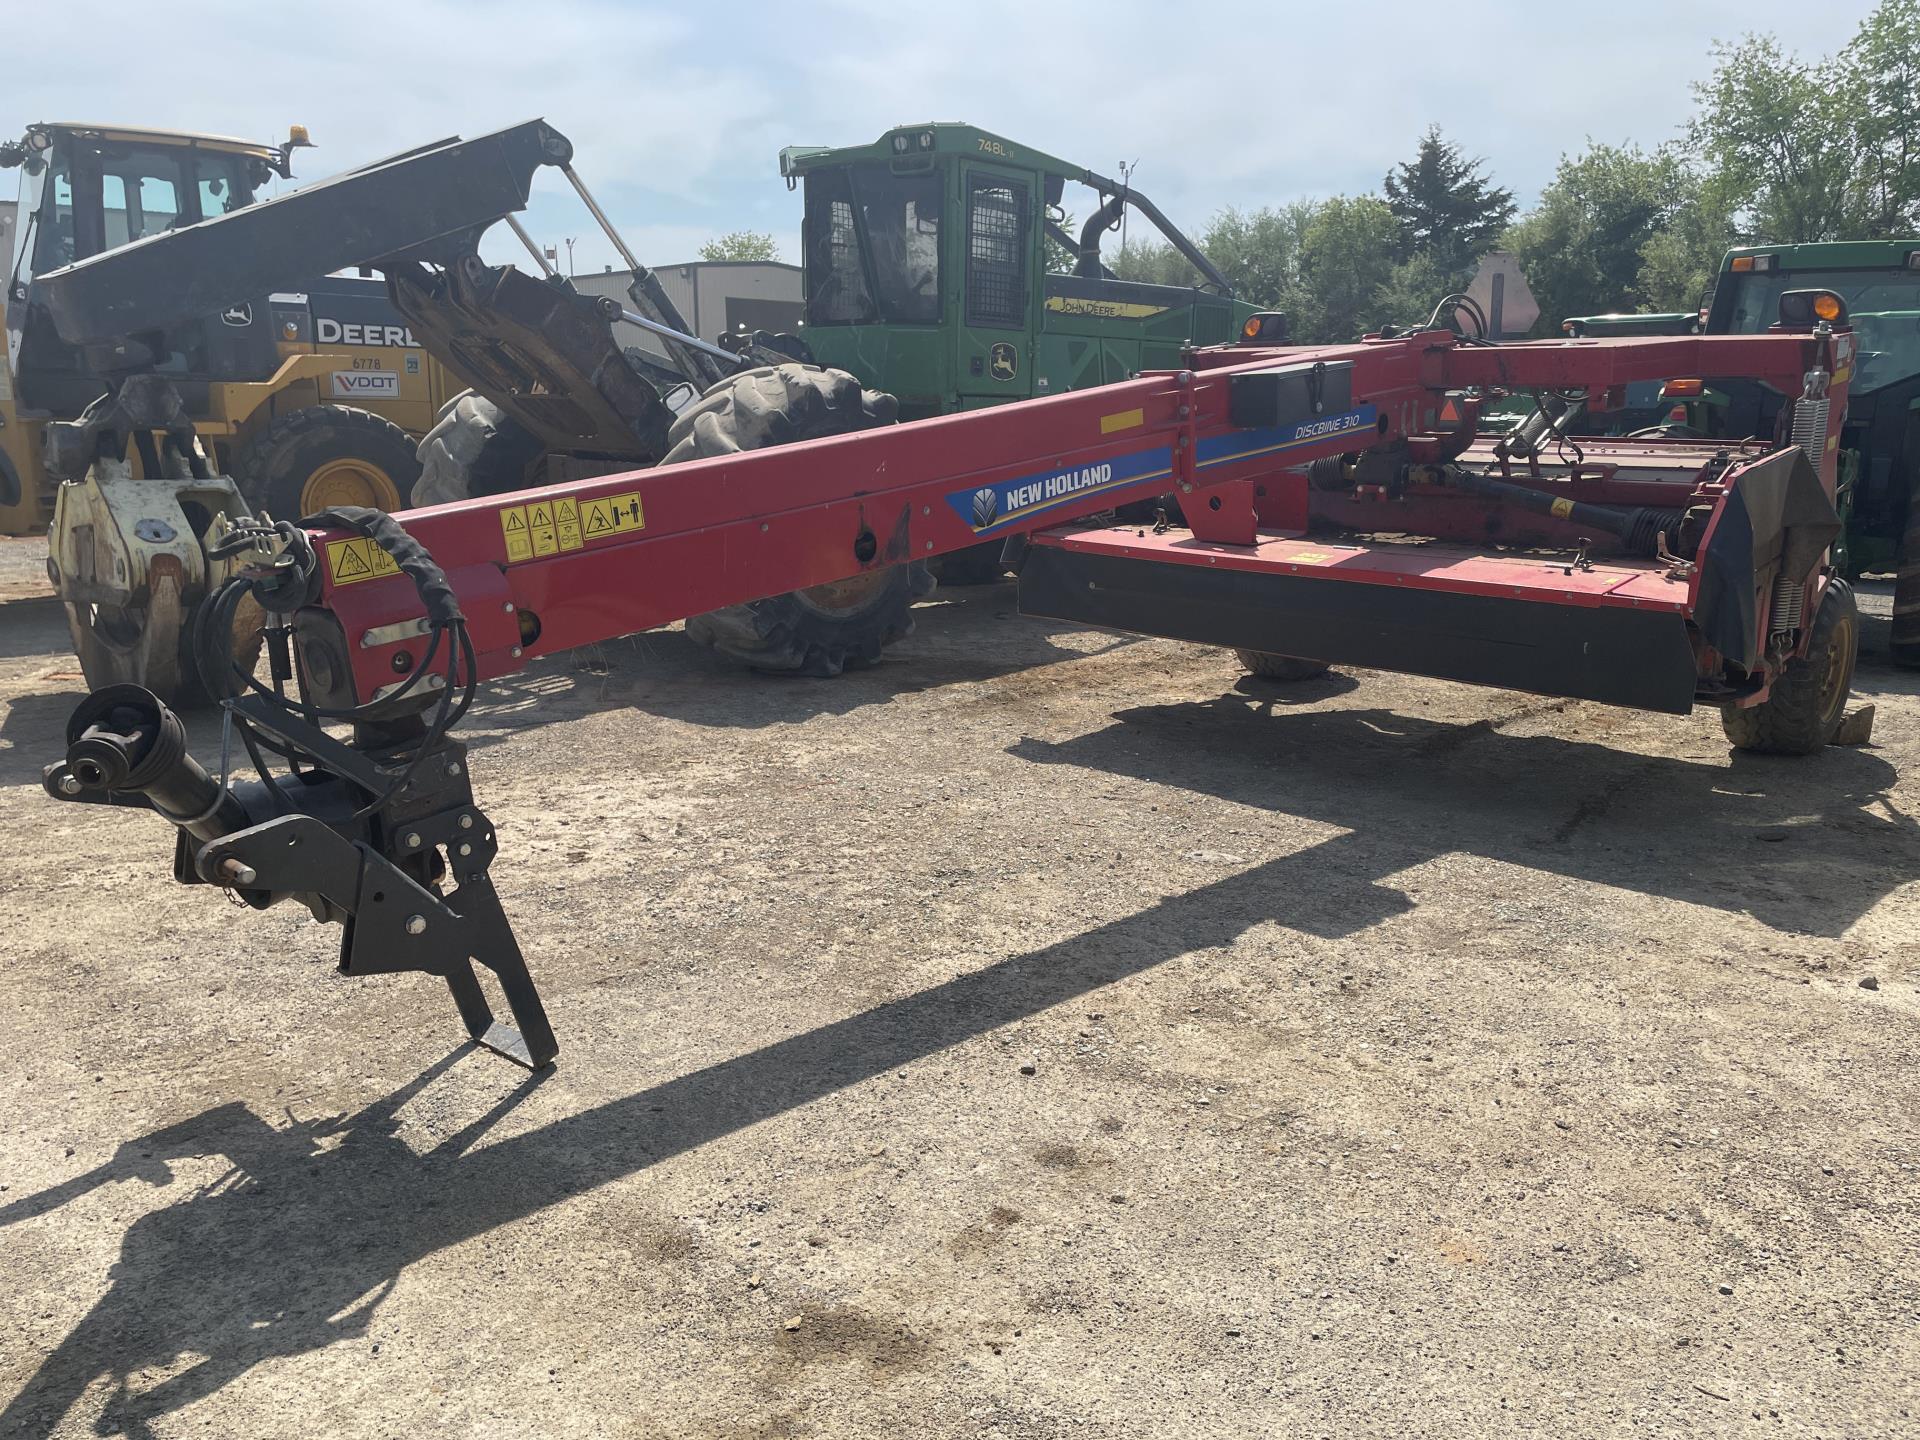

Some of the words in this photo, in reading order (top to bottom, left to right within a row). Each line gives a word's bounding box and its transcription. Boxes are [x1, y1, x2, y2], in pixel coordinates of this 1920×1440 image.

[1060, 301, 1085, 313] JOHN
[1086, 303, 1116, 316] DEERE
[352, 358, 381, 370] 6778
[336, 375, 395, 391] VDOT
[1295, 418, 1341, 439] DISCBINE
[1342, 414, 1360, 429] 310
[1007, 481, 1043, 511] NEW
[1045, 463, 1112, 498] HOLLAND
